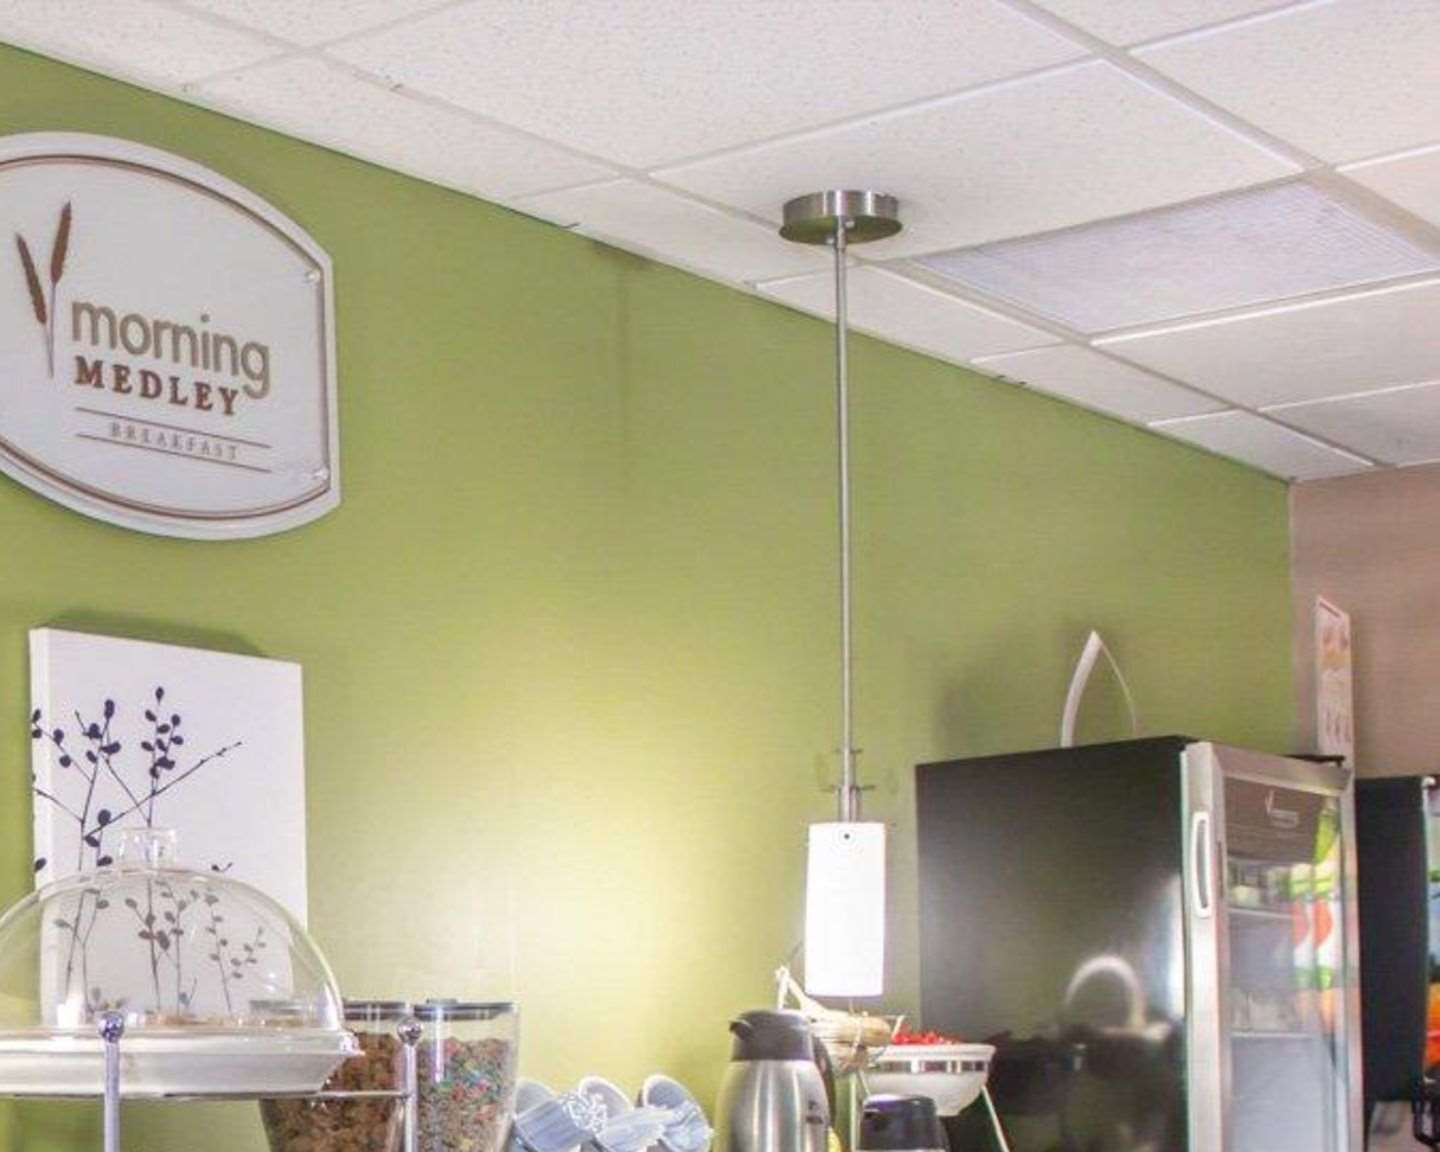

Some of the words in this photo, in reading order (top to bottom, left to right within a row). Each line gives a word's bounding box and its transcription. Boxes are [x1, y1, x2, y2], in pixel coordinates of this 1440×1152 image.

[71, 300, 270, 400] morning
[74, 355, 239, 415] MEDLEY
[111, 421, 238, 460] BREAKFAST
